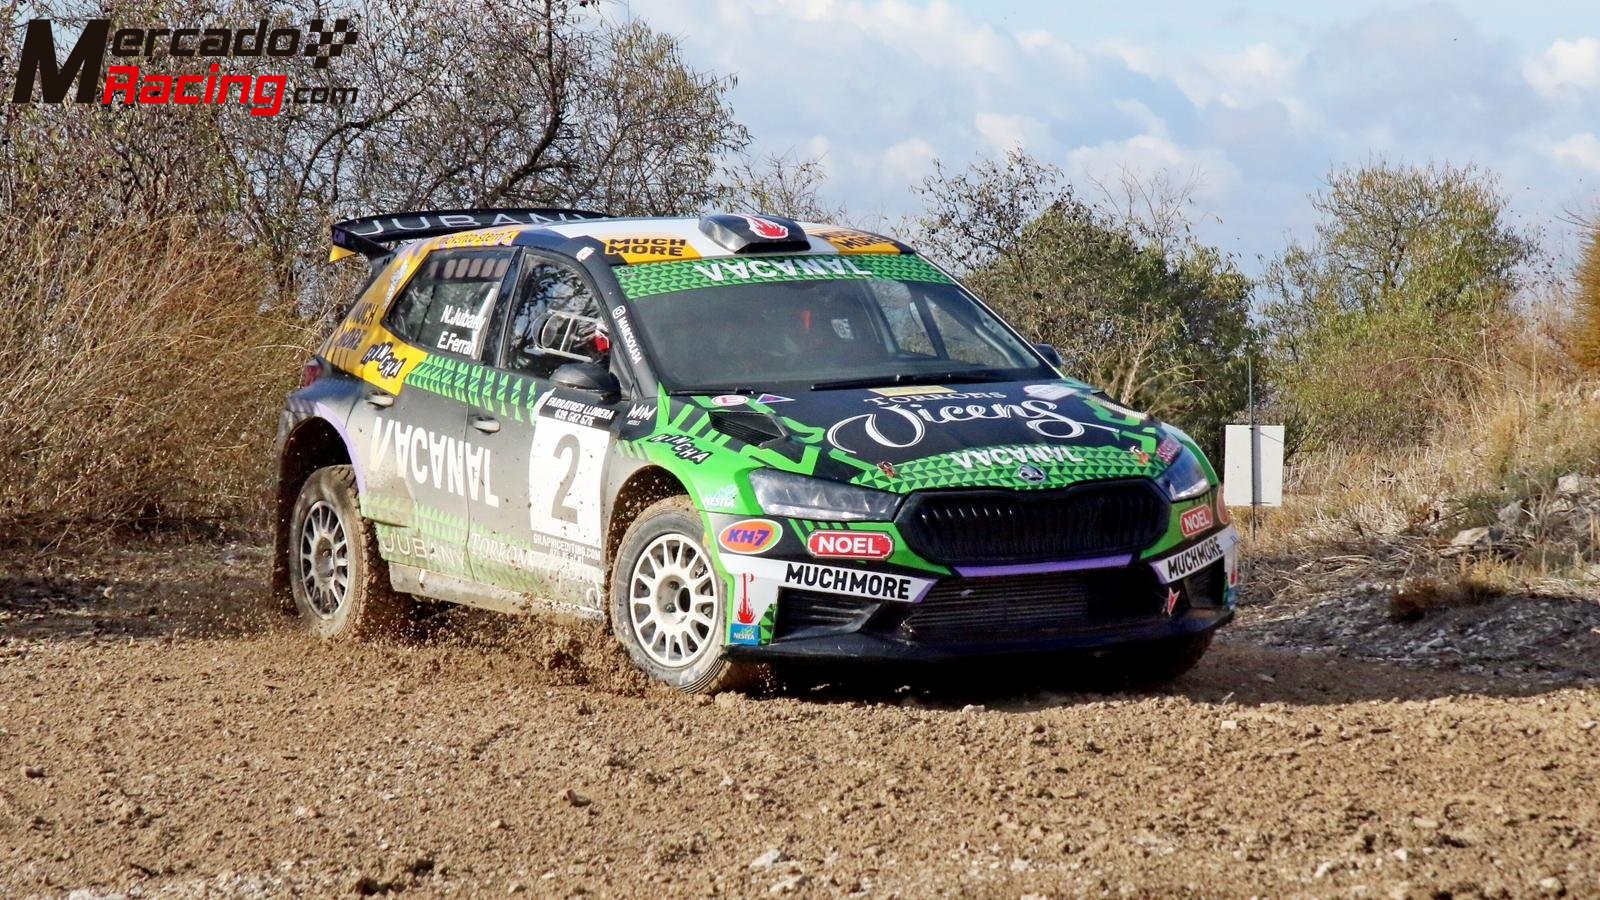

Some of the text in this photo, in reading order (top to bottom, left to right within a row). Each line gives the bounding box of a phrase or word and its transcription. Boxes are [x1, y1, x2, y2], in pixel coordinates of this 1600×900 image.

[351, 212, 586, 236] JUBAN
[608, 246, 683, 256] MORE
[610, 238, 687, 247] MUCH
[864, 391, 1007, 405] TORRONS
[826, 399, 1120, 454] Vicens
[646, 434, 714, 465] HINCHA
[551, 433, 581, 525] 2
[1184, 513, 1210, 533] NOEL
[818, 536, 881, 555] NOEL
[1167, 536, 1224, 579] MUCHMORE
[785, 563, 911, 600] MUCHMORE
